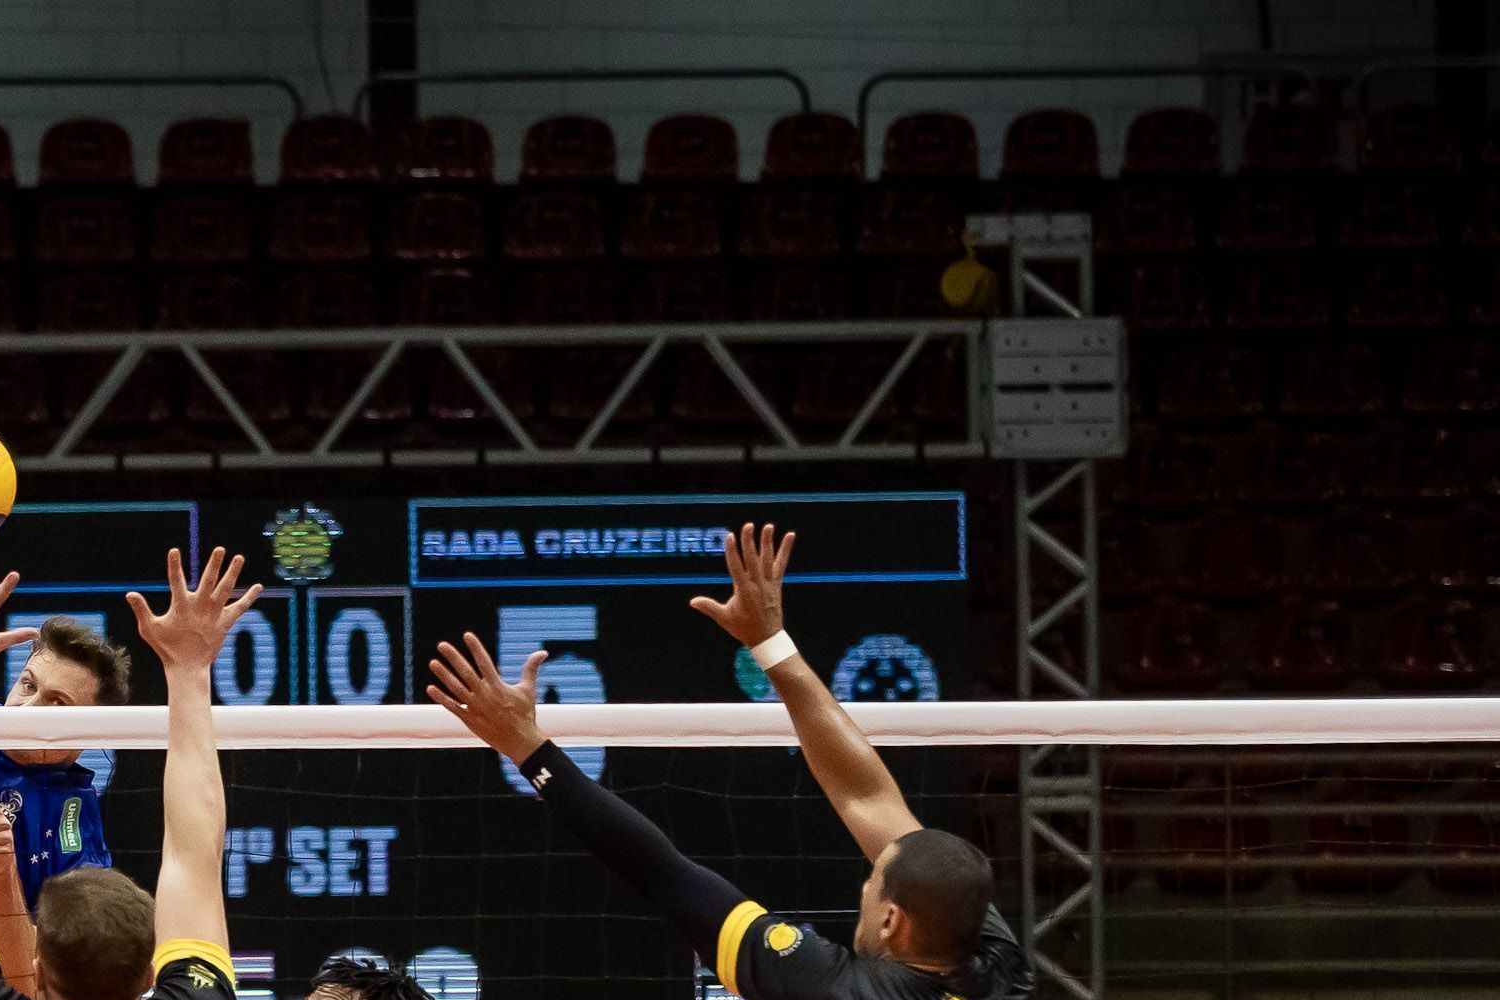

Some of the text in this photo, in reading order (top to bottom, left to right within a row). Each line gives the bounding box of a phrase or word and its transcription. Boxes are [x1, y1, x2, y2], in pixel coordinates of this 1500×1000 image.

[422, 528, 728, 557] SADA CRUZEIRO
[213, 609, 278, 706] 0
[326, 608, 391, 706] 0
[67, 802, 77, 848] Unimed
[286, 826, 398, 897] SET
